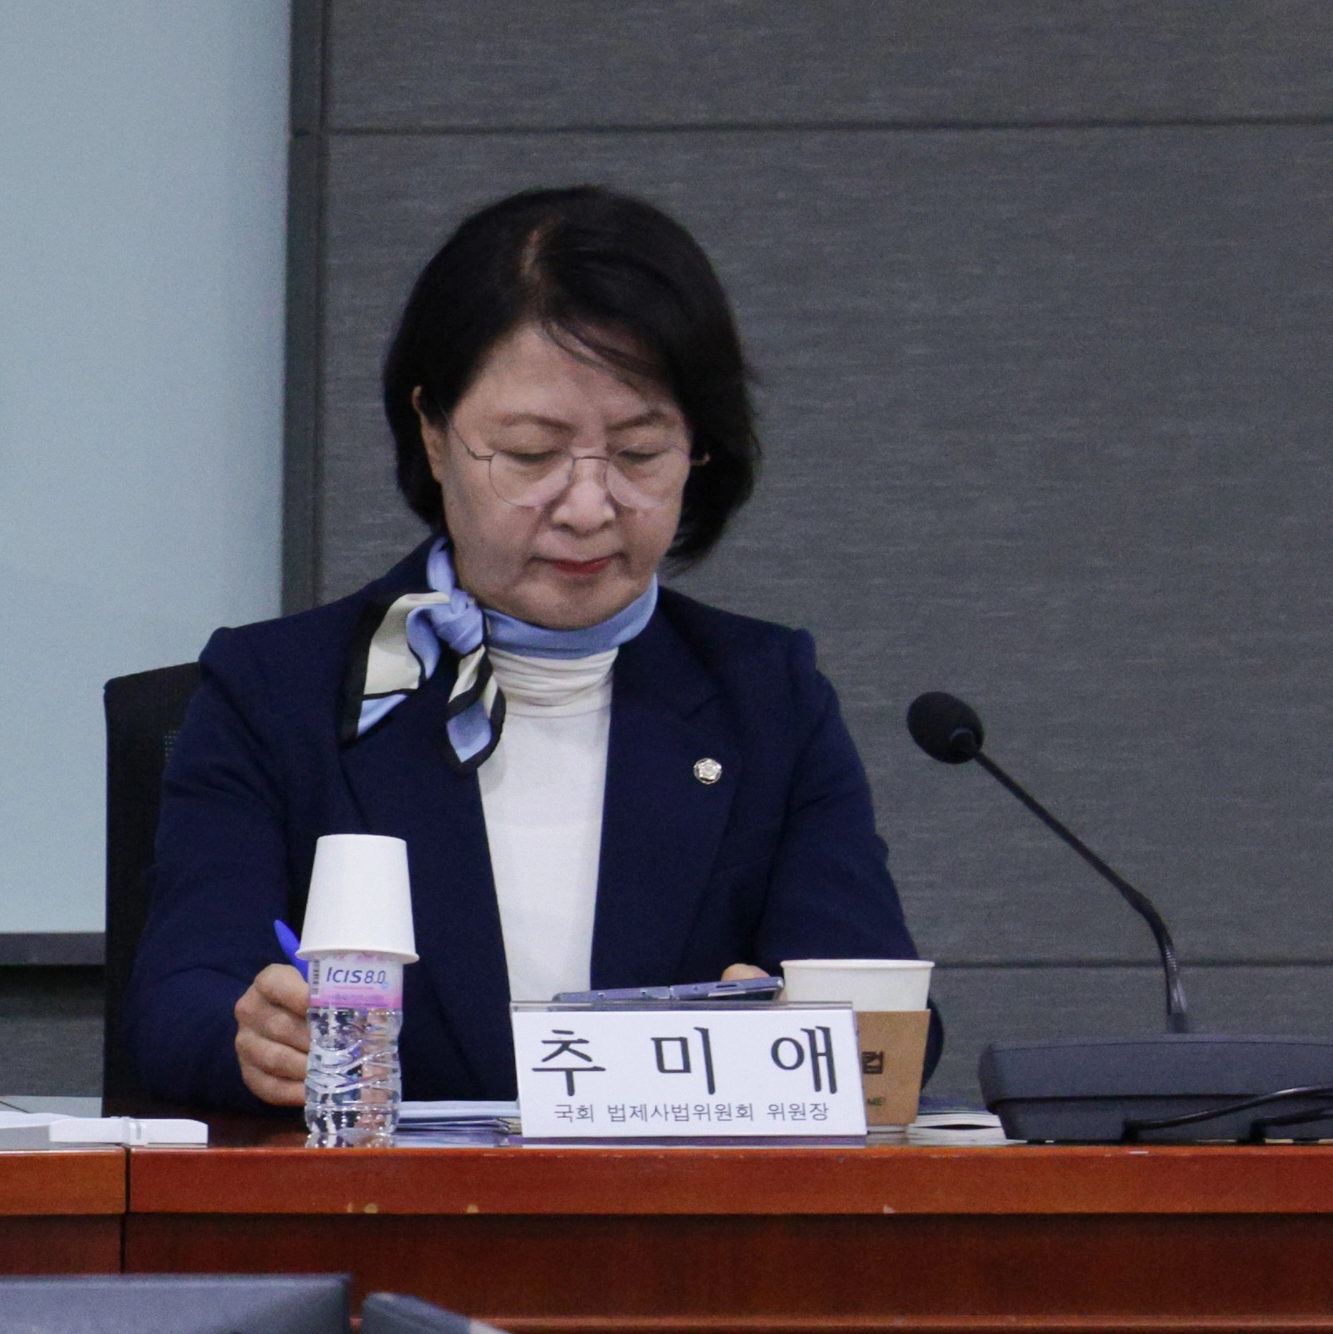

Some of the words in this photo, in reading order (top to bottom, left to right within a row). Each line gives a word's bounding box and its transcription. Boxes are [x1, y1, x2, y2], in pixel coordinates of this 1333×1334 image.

[553, 1104, 595, 1123] 국회
[606, 1103, 754, 1122] 법제사법위원회
[766, 1102, 829, 1122] 위원장
